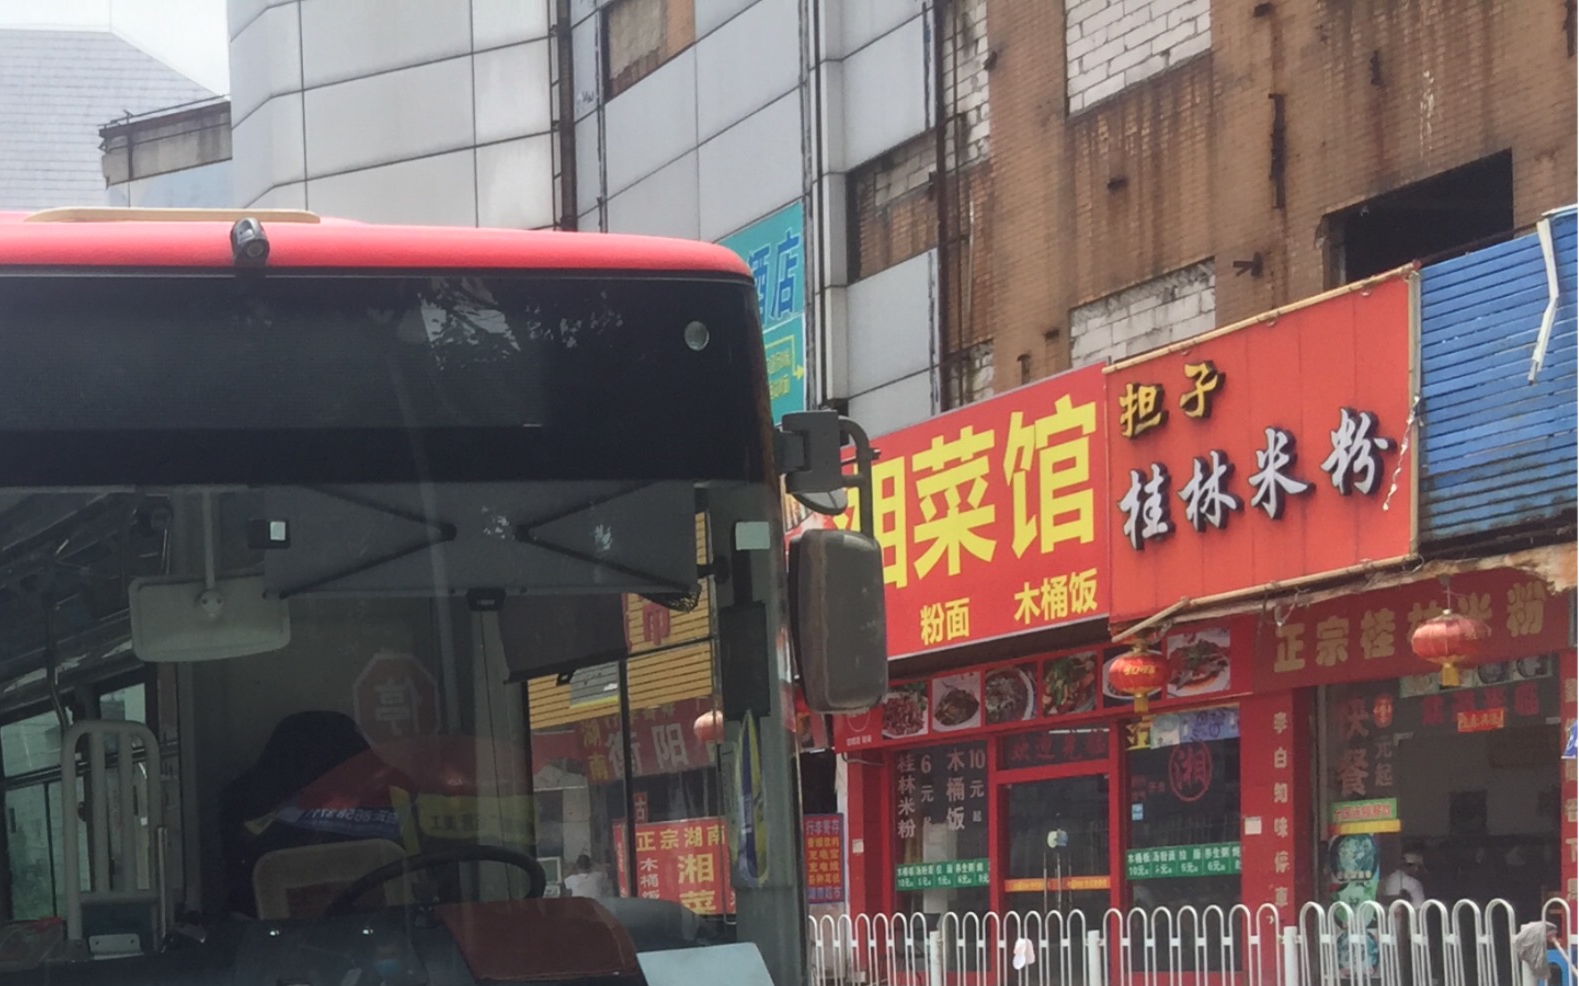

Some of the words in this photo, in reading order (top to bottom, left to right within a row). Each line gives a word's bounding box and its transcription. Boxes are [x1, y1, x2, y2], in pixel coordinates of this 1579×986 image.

[1119, 360, 1224, 440] 担子
[1116, 406, 1396, 551] 桂林米粉
[920, 597, 971, 645] 粉面
[1013, 568, 1098, 625] 木桶饭
[897, 753, 917, 839] 桂林米粉
[946, 750, 966, 832] 木桶饭
[635, 825, 726, 851] 正宗湖南
